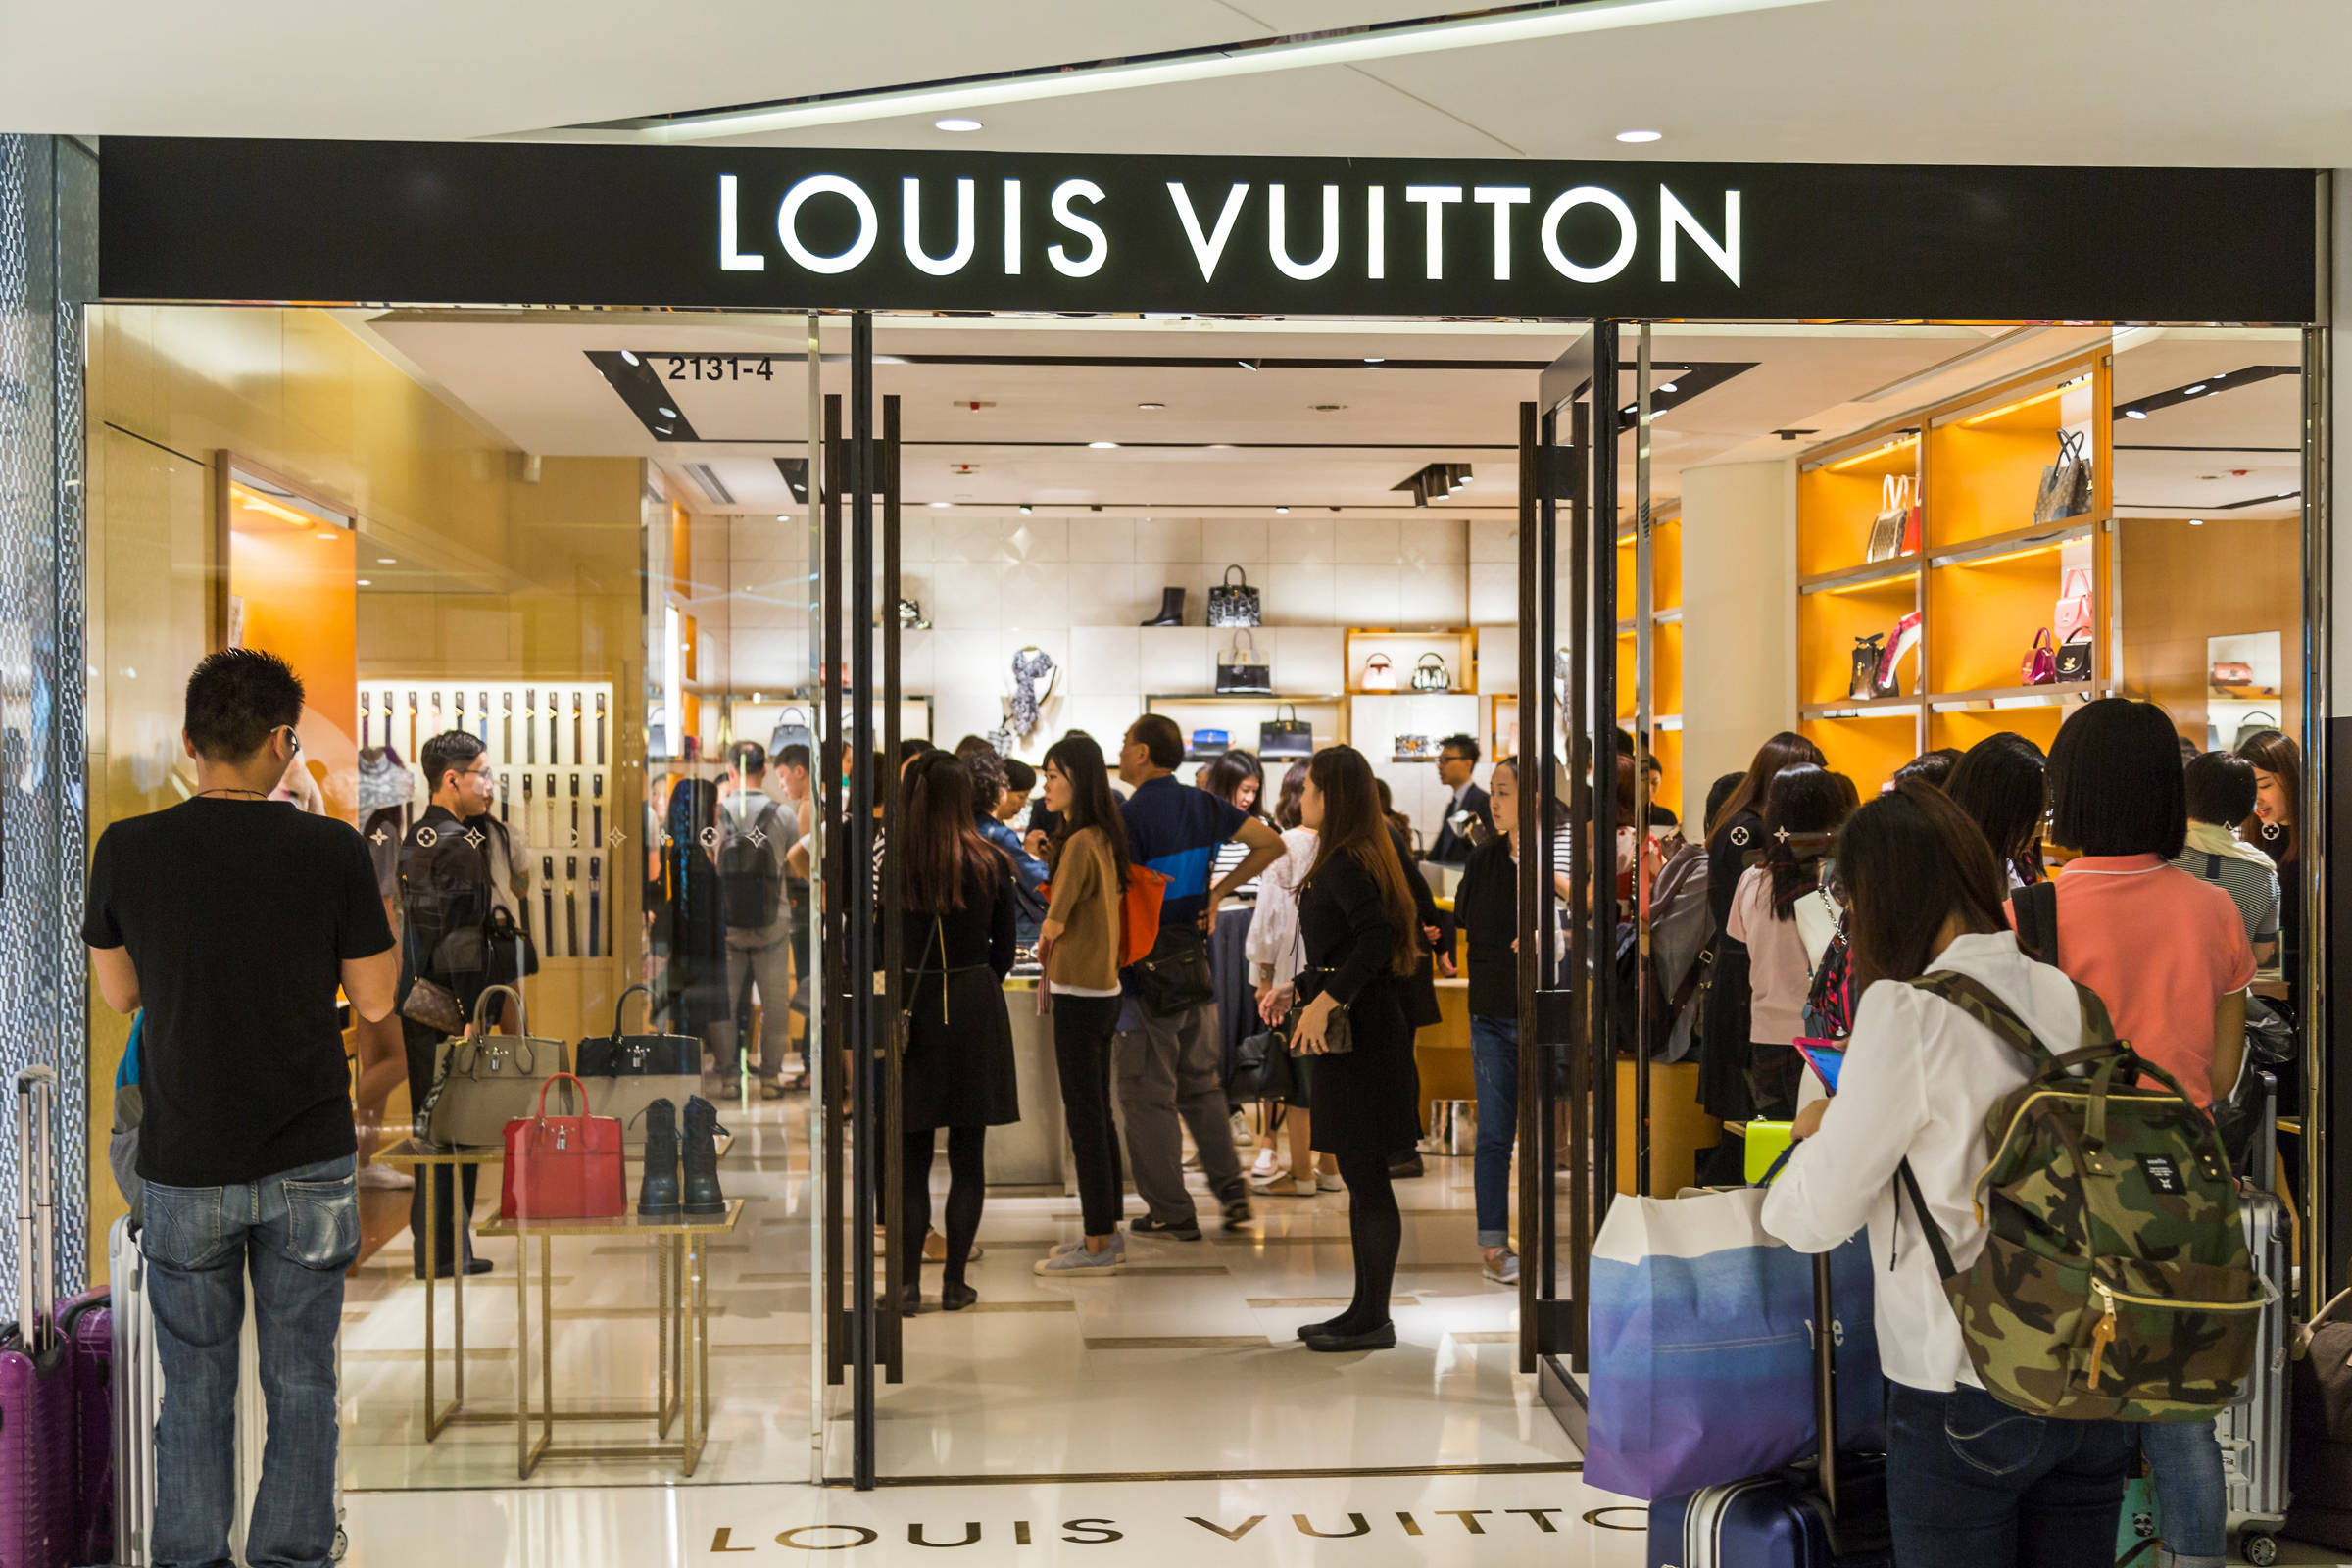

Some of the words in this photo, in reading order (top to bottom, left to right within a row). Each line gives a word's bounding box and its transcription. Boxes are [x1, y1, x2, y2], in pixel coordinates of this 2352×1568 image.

[720, 174, 1109, 278] LOUIS
[1166, 182, 1742, 289] VUITTON
[668, 356, 774, 381] 2131-4
[711, 1518, 1124, 1552] LOUIS
[1184, 1506, 1649, 1541] VUITTO
